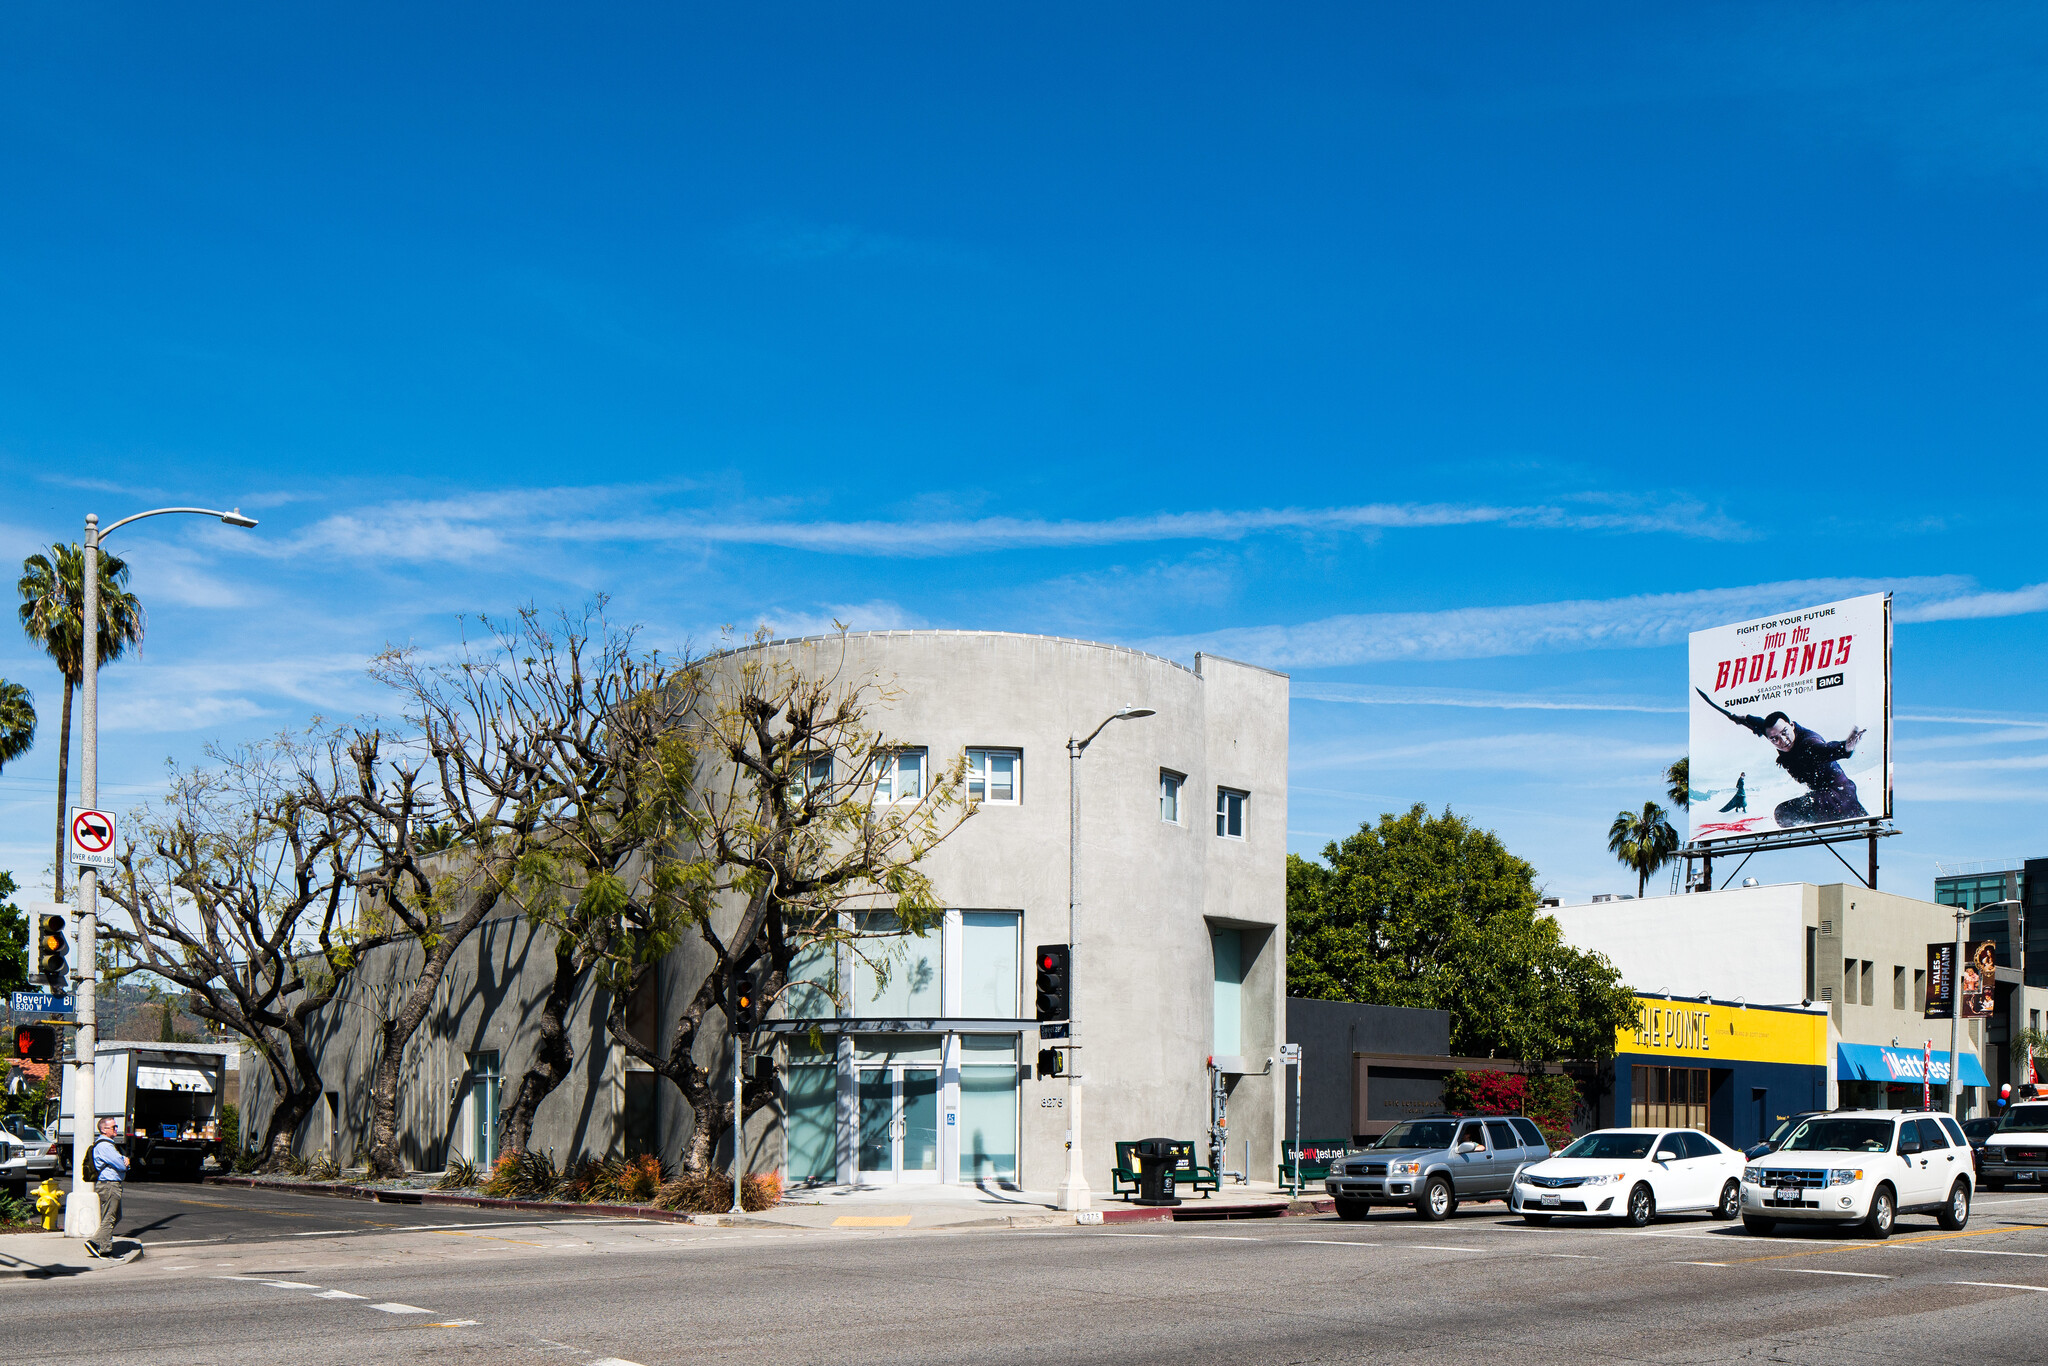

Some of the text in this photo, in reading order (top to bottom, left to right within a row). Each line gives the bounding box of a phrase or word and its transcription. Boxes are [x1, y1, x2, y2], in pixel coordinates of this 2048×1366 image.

[1736, 608, 1836, 635] FIGHT FOR YOUR FUTURE
[1764, 626, 1810, 651] into the
[1714, 635, 1853, 693] BADLANDS
[1724, 694, 1760, 707] SUNDAY
[1762, 691, 1780, 700] MAR
[1784, 688, 1792, 696] 19
[1758, 678, 1814, 694] SEASON PREMIERE
[72, 852, 86, 860] OVER
[1932, 960, 1940, 984] TALES
[1940, 947, 1950, 999] HOFFMANN
[16, 994, 52, 1007] Beverly
[1665, 1008, 1710, 1050] PONTE
